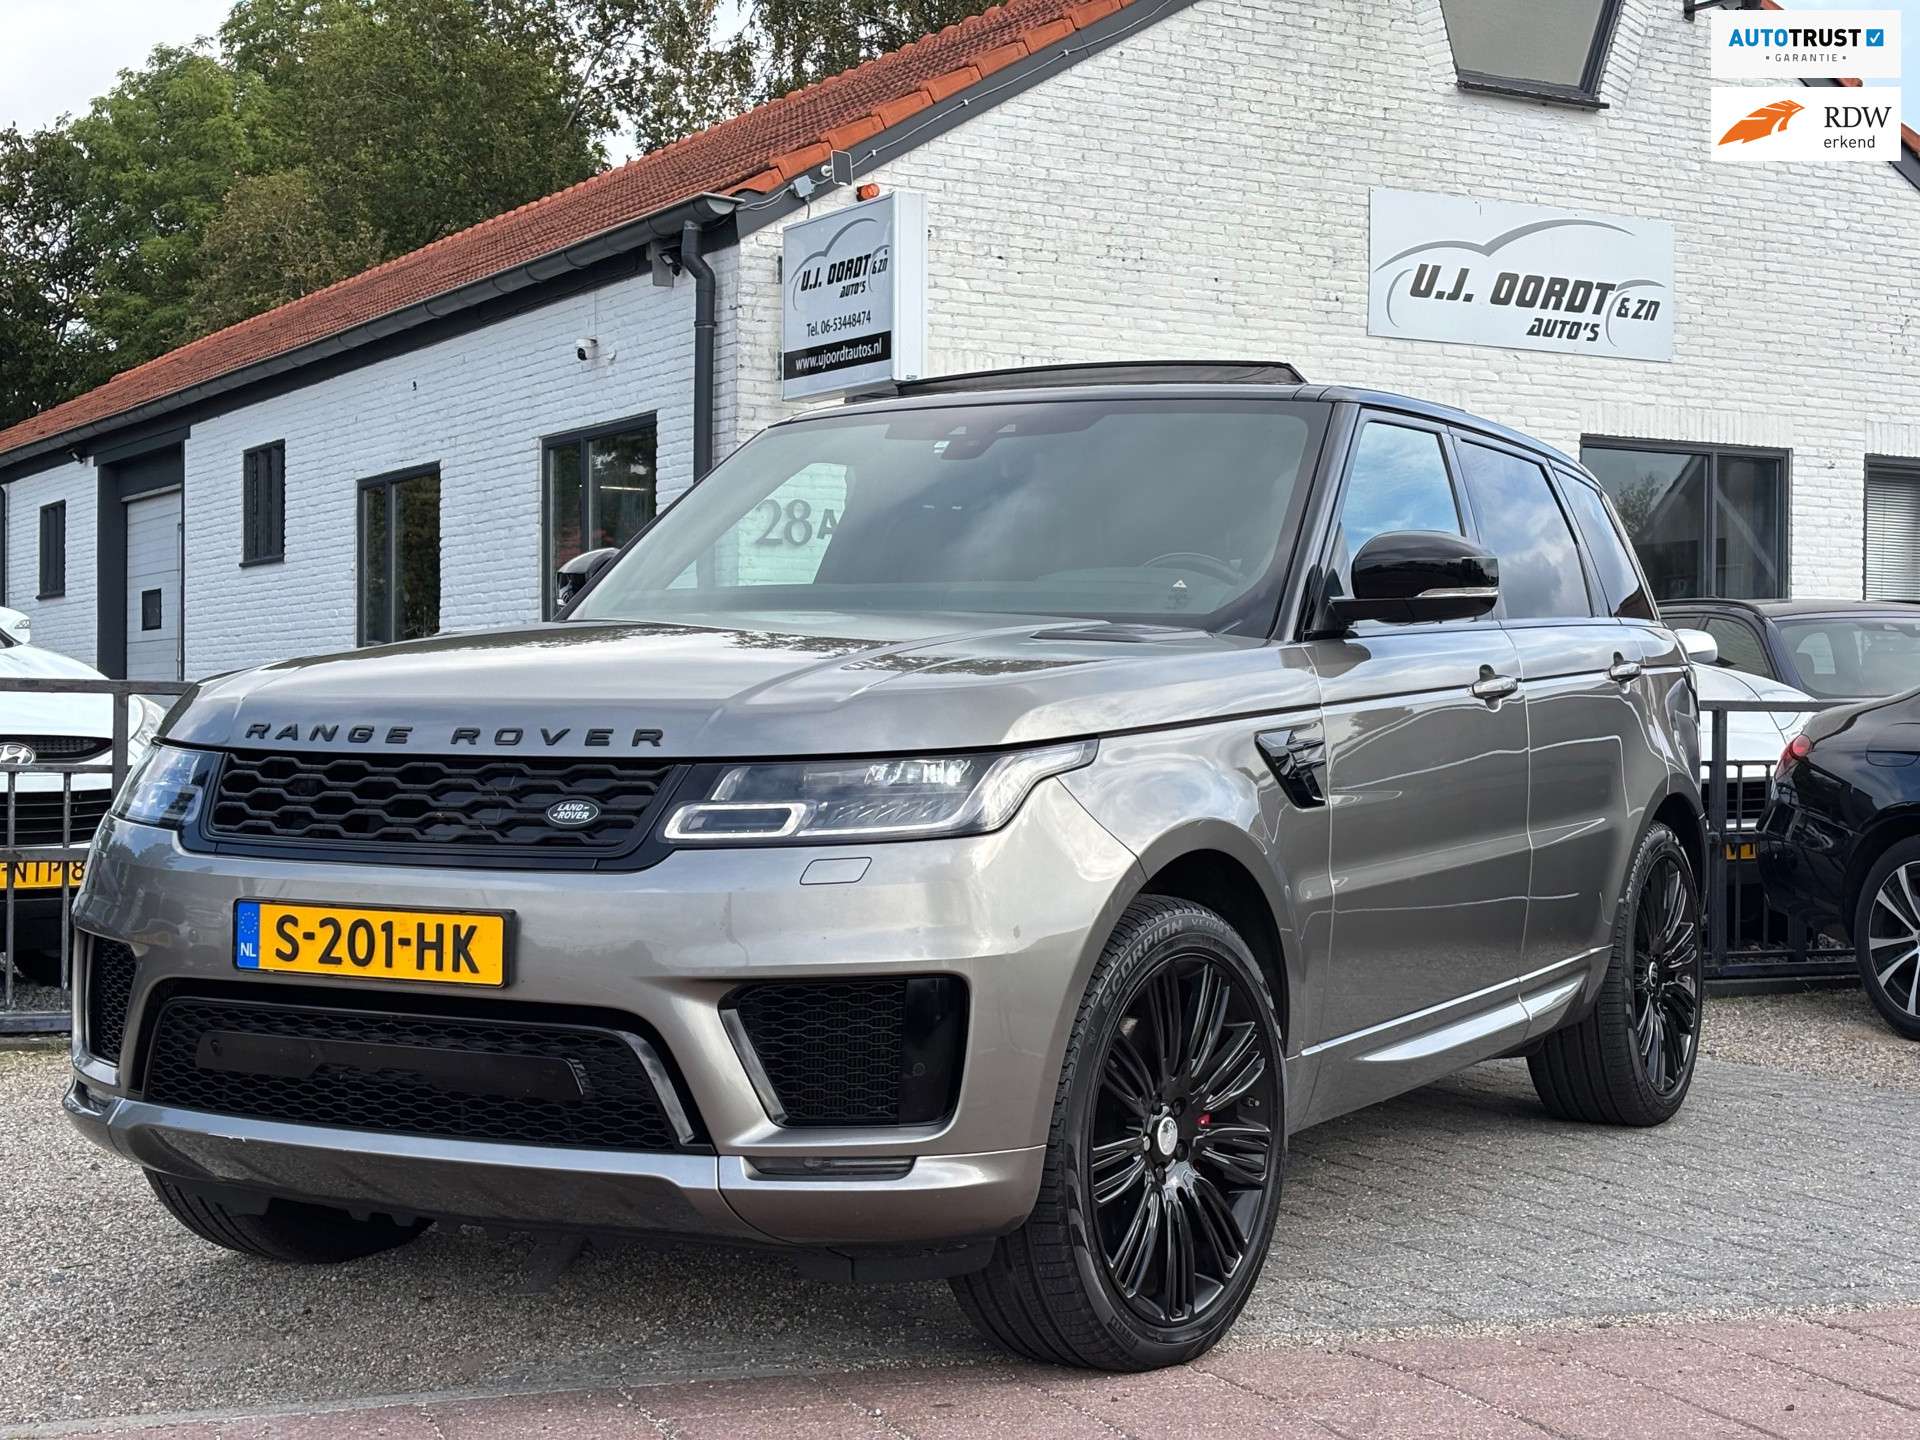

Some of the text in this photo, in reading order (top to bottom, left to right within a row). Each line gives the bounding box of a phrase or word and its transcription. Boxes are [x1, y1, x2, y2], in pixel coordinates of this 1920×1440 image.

[800, 267, 822, 291] U.J.
[827, 253, 872, 285] OORDT
[1409, 263, 1475, 303] U.J.
[1490, 271, 1617, 315] OORDT
[806, 310, 872, 337] Tel. 06-53448474
[1526, 317, 1601, 342] AUTO'S
[795, 337, 882, 371] www.ujoordtautos.nl
[245, 722, 664, 748] RANGE ROVER
[240, 913, 480, 974] NL S-201-HK
[1102, 918, 1184, 1008] SCORPION
